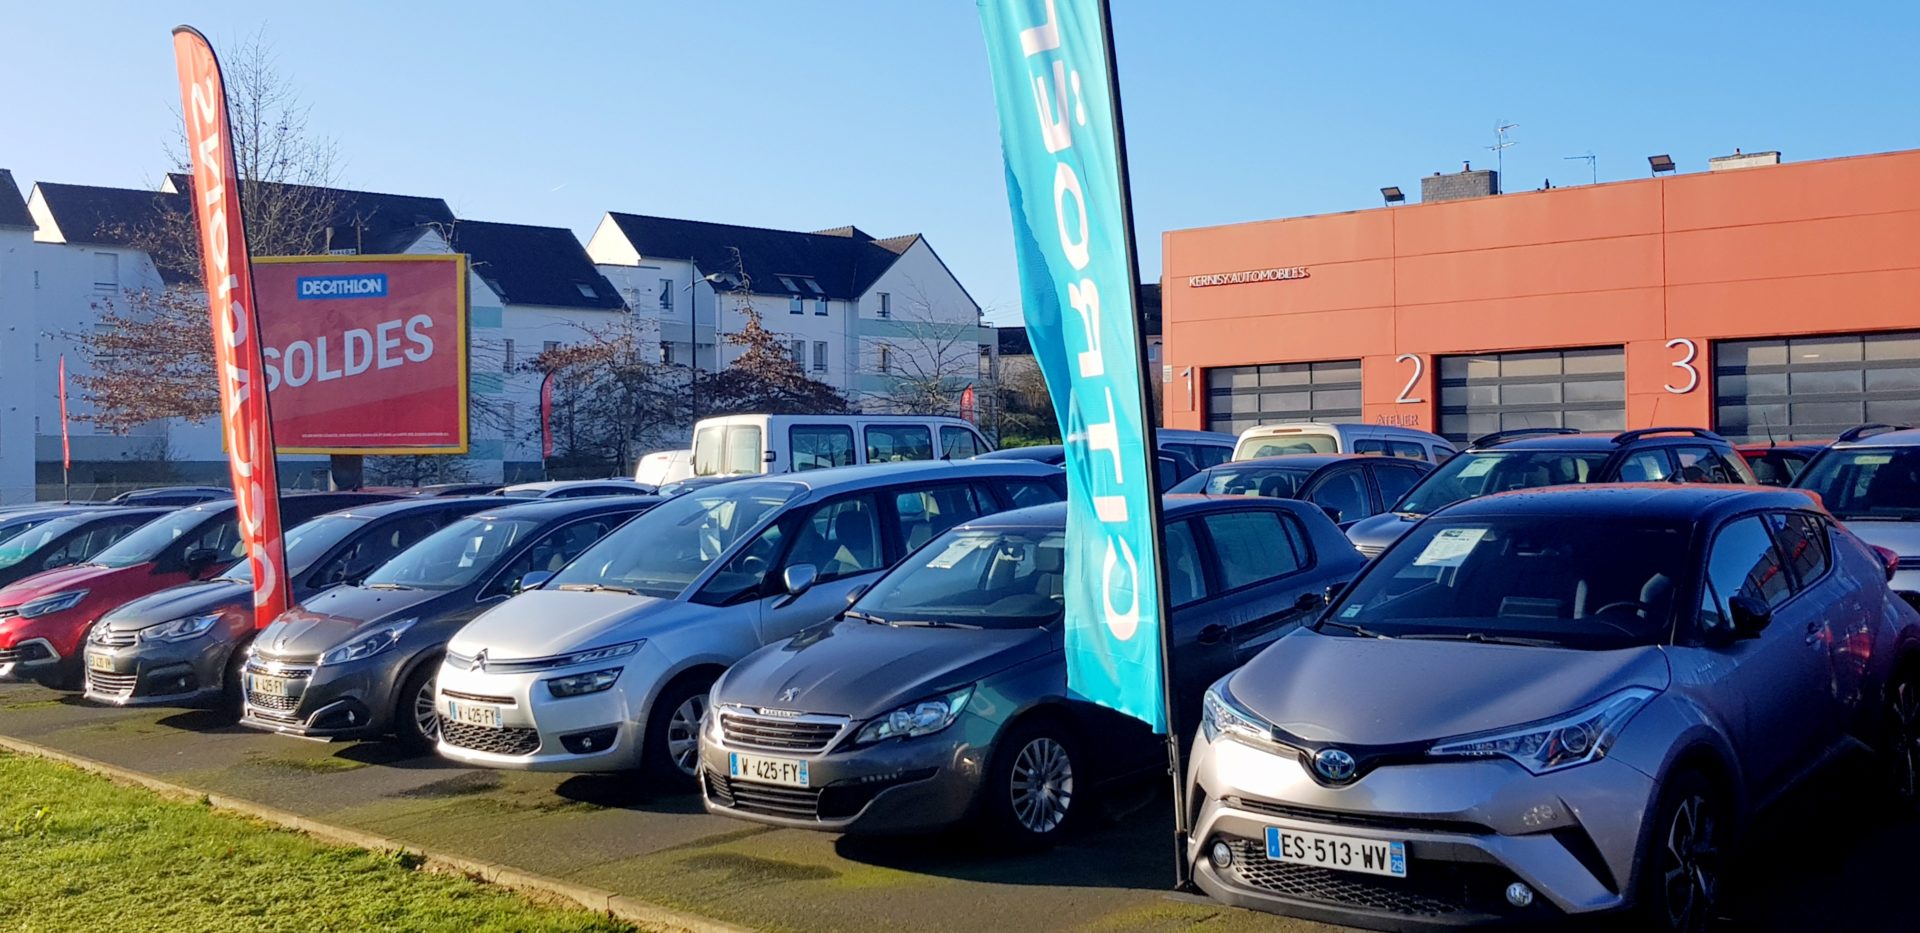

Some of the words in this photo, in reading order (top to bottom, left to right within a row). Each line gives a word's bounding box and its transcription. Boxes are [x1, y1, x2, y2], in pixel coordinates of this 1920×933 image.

[302, 278, 382, 295] DECATHLON
[1188, 272, 1229, 287] KERNISY
[1232, 266, 1307, 283] AUTOMOBILES
[263, 314, 434, 393] SOLDES
[1664, 338, 1697, 394] 3
[1180, 365, 1194, 411] 1
[1395, 353, 1422, 403] 2
[1281, 834, 1387, 870] ES-513-WV
